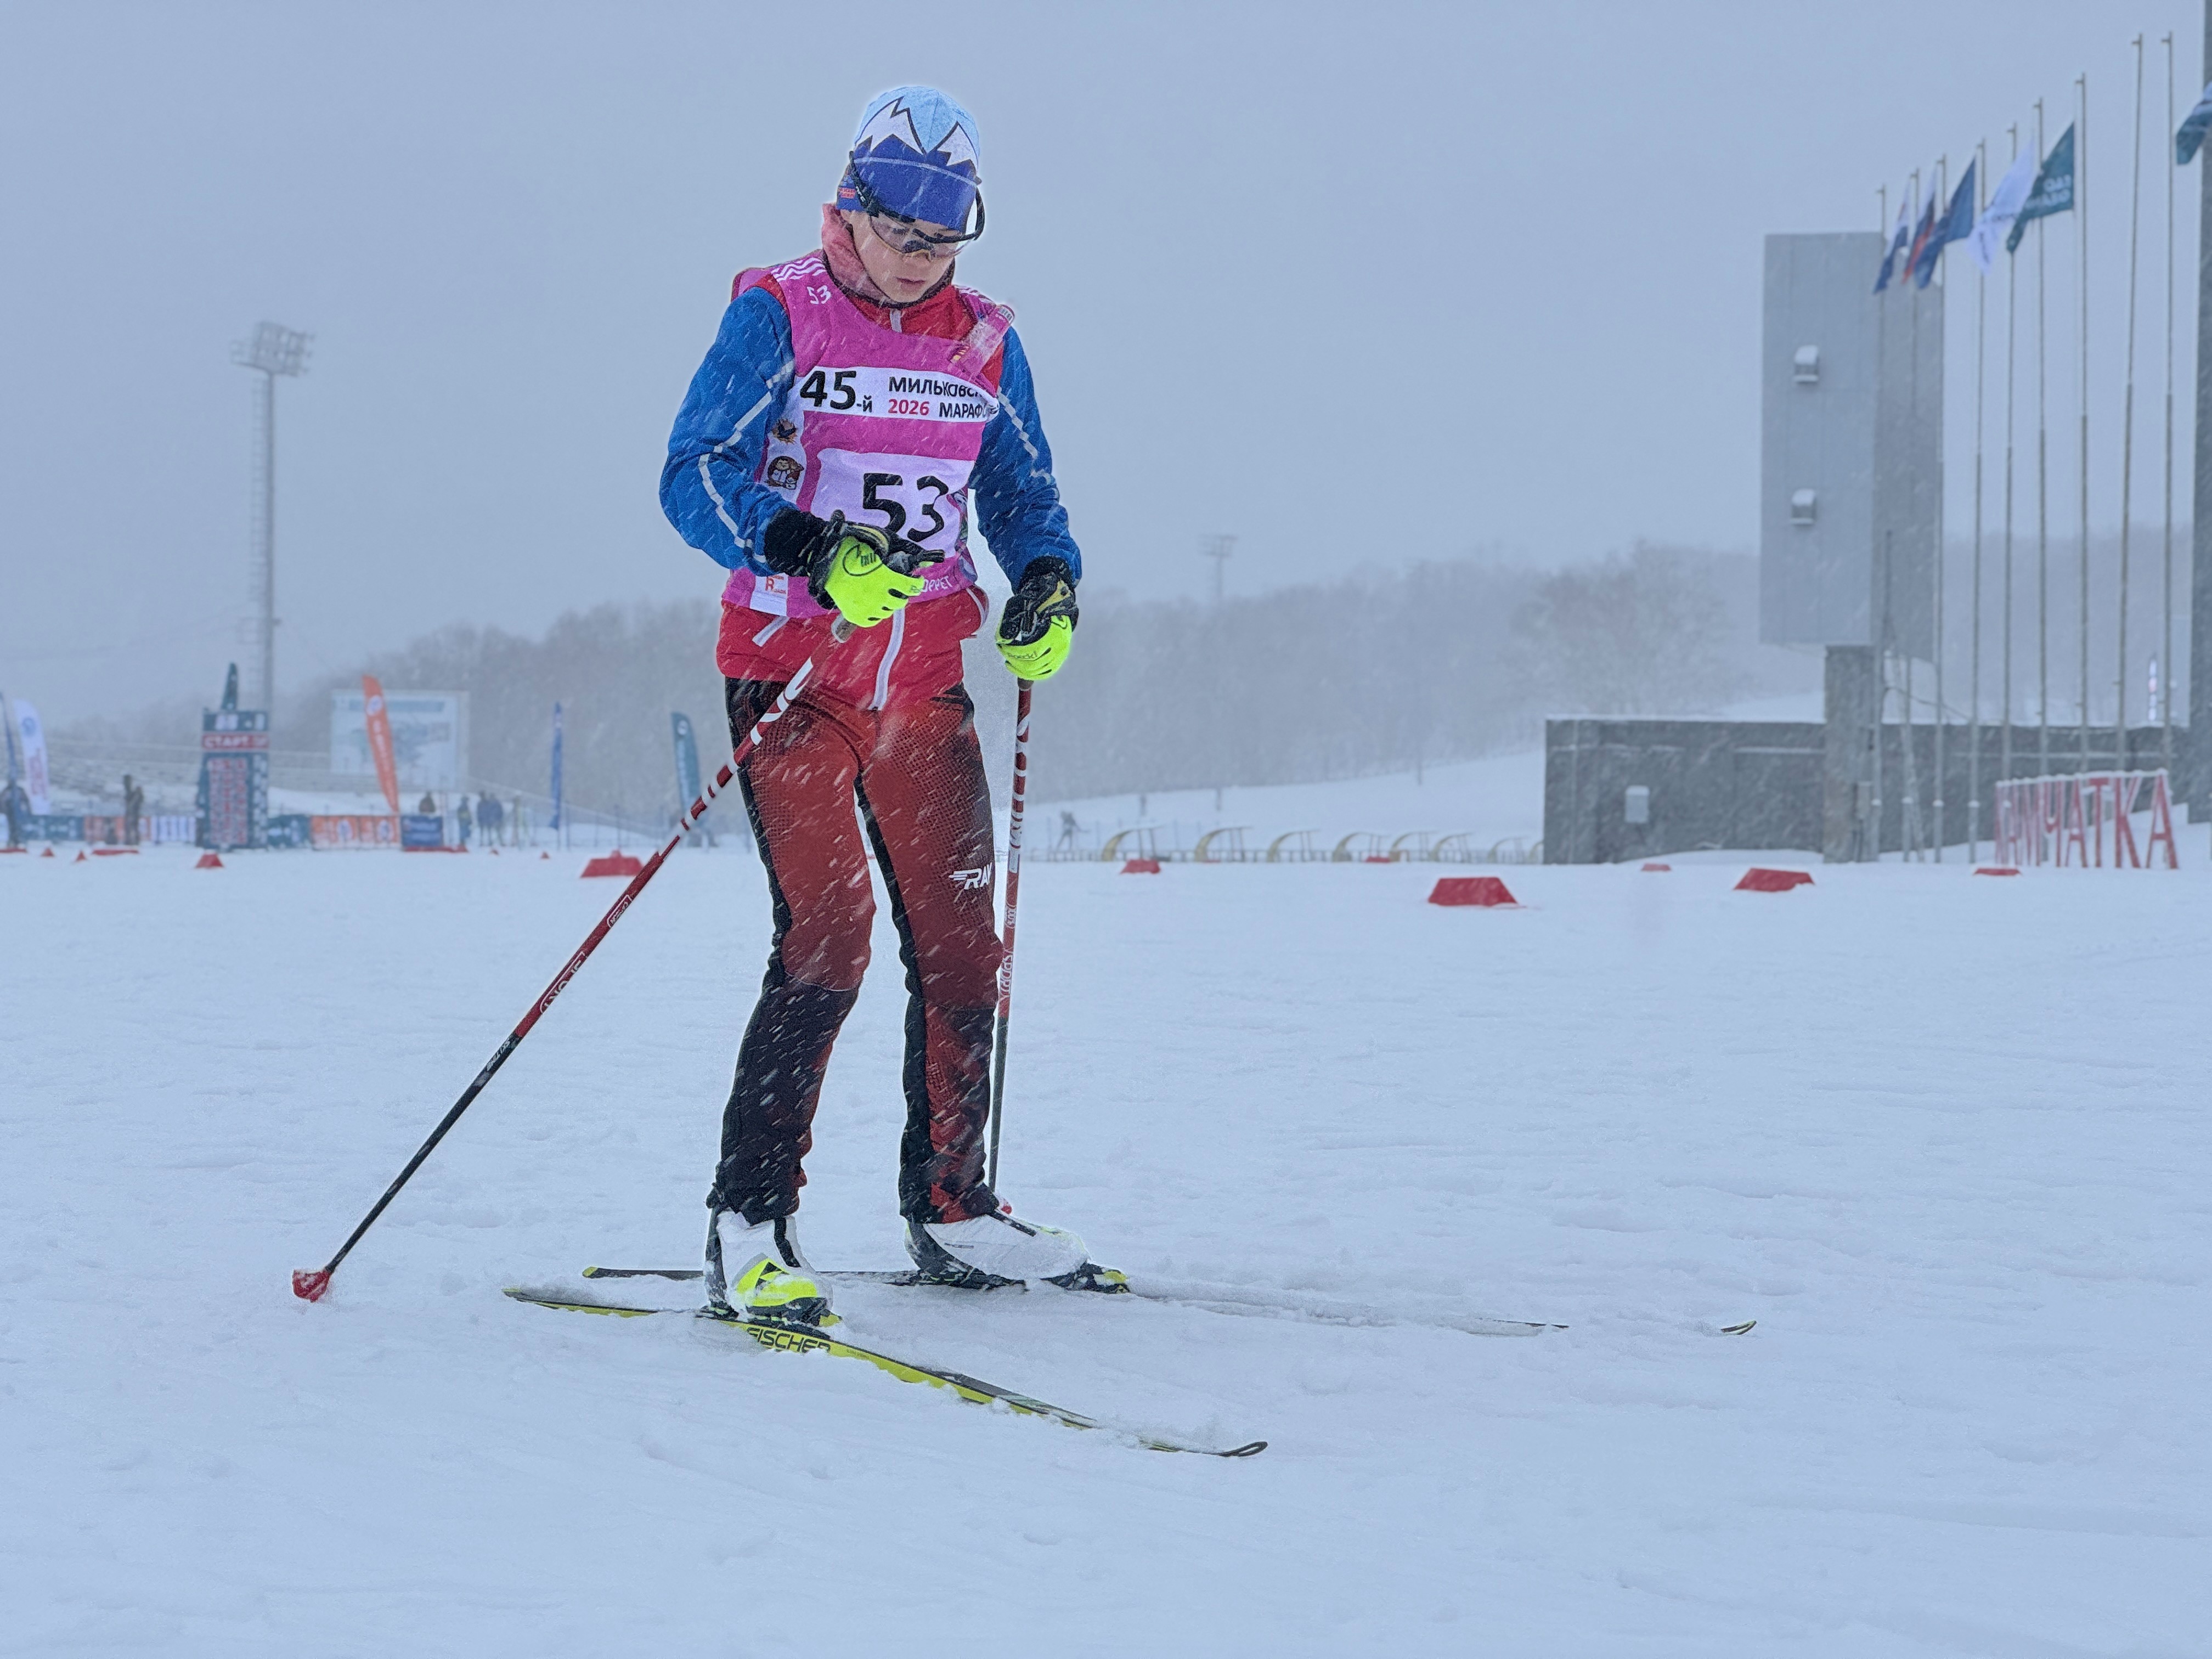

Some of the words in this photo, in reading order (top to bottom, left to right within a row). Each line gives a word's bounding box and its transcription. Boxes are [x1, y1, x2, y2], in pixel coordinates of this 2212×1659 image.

[806, 285, 831, 304] 53
[800, 370, 872, 413] 45-й
[888, 376, 982, 397] МИЛЬКОВС
[888, 399, 930, 416] 2026
[862, 473, 949, 543] 53
